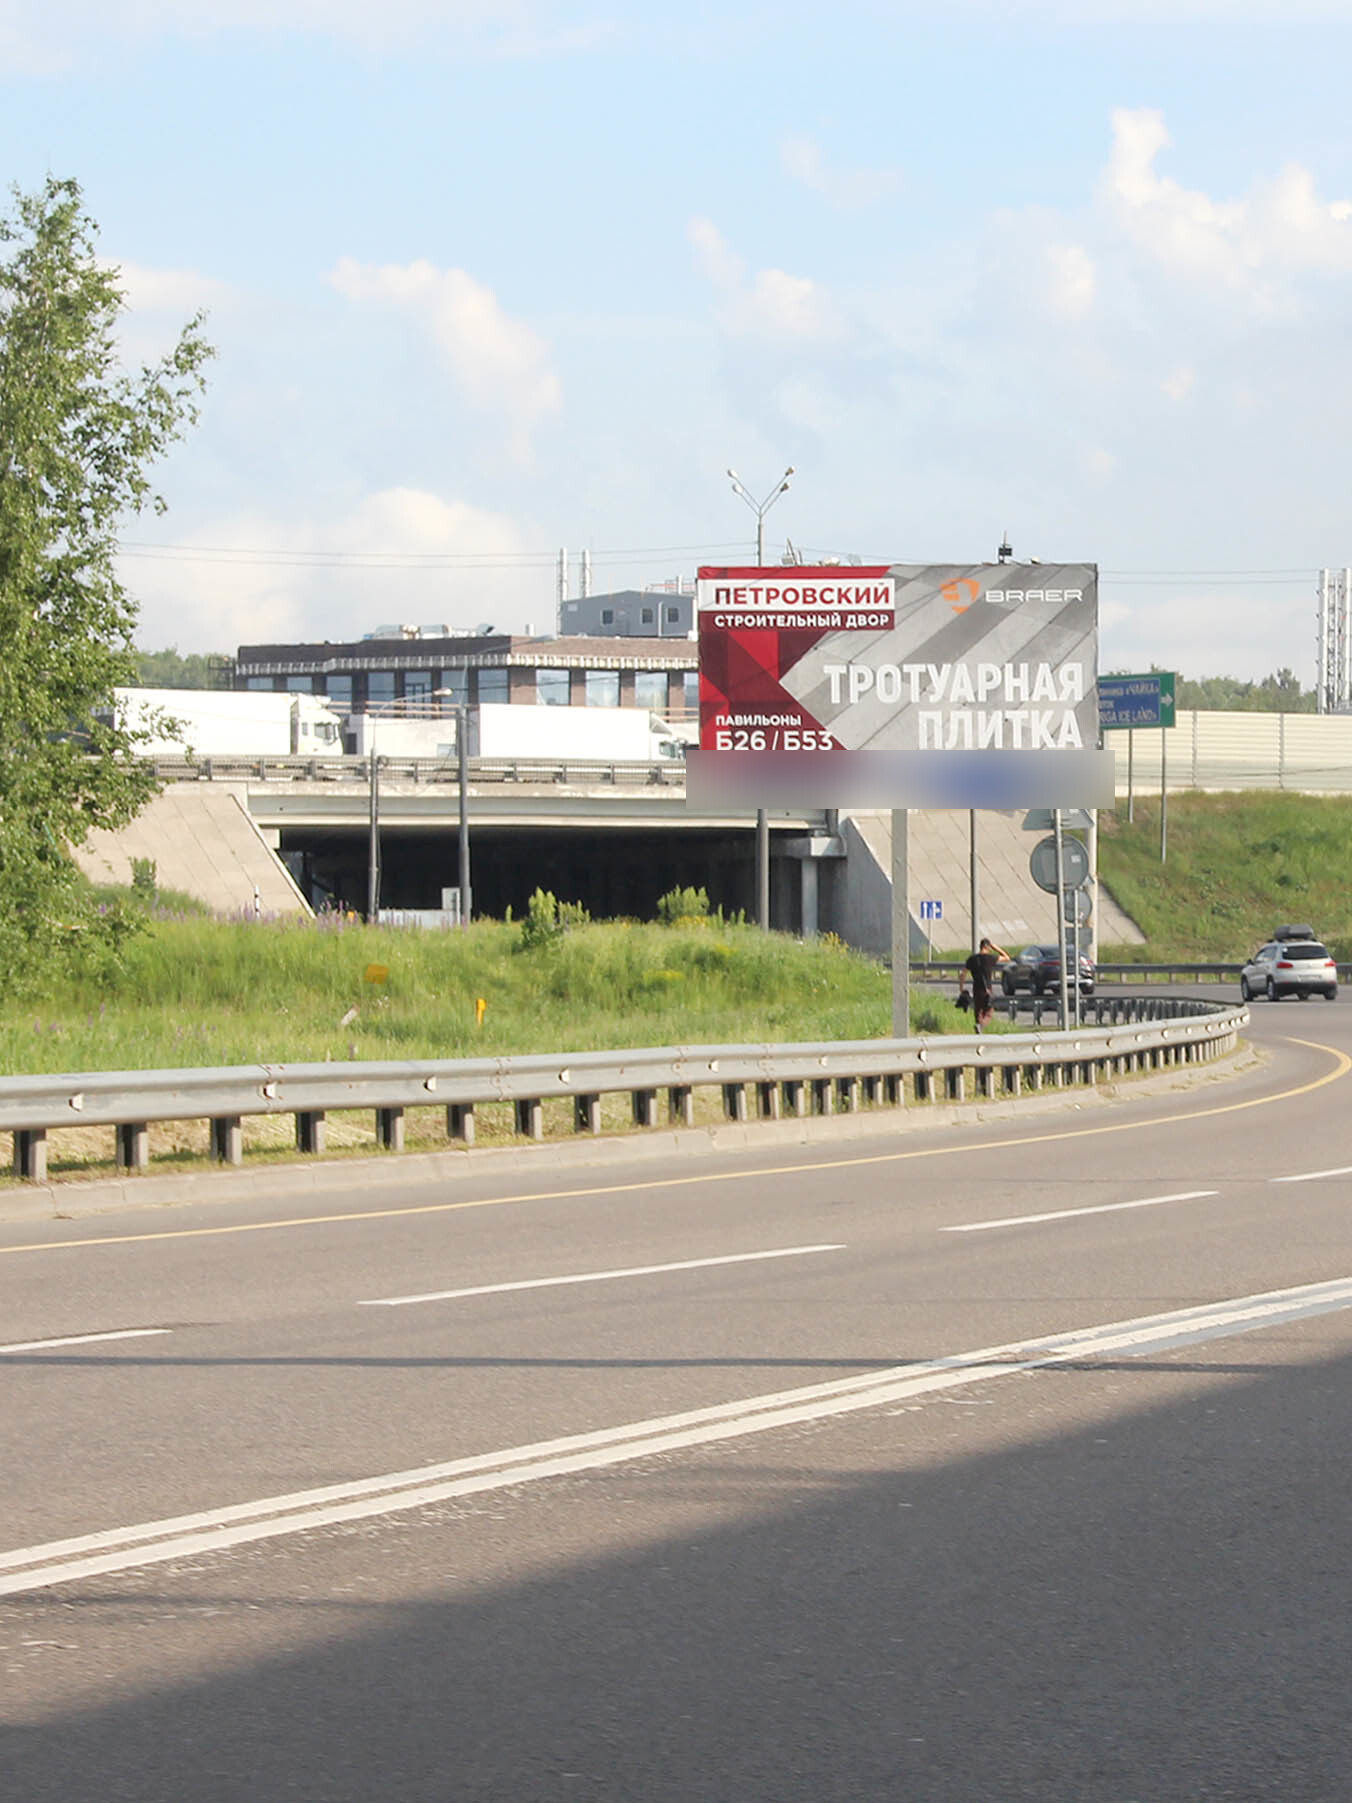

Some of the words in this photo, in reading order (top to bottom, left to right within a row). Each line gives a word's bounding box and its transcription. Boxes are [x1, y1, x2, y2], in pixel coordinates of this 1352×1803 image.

[714, 582, 890, 605] ПЕТРОВСКИЙ
[985, 588, 1083, 602] BRAER
[714, 612, 841, 628] СТРОИТЕЛЬНЫЙ
[844, 613, 889, 629] ДВОР
[823, 662, 1083, 705] ТРОТУАРНАЯ
[715, 714, 802, 726] ПАВИЛЬОНЫ
[918, 709, 1083, 750] ПЛИТКА
[715, 730, 767, 750] Б26
[783, 730, 834, 750] Б53
